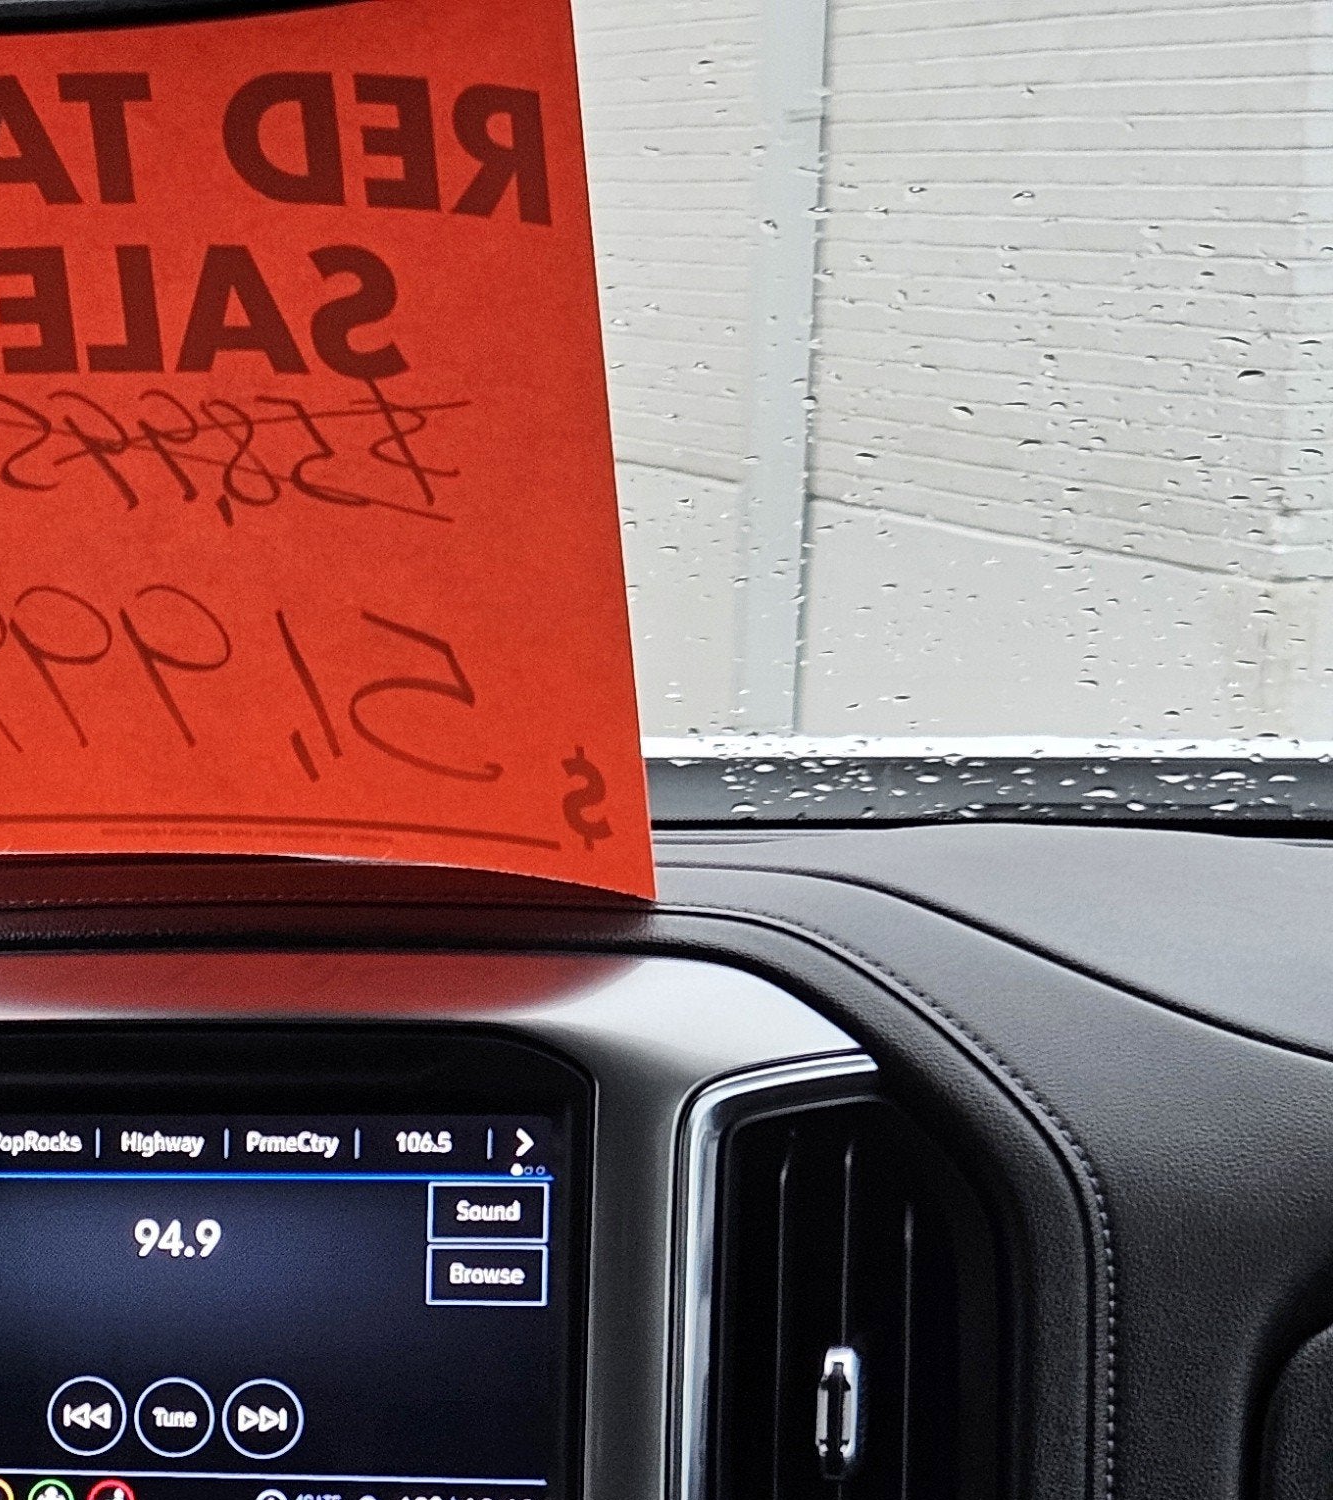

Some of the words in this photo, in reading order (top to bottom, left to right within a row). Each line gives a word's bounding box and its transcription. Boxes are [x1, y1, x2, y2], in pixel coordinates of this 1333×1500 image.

[121, 1130, 205, 1158] Highway
[246, 1130, 340, 1158] PrmeCtry
[396, 1131, 453, 1153] 106.5
[456, 1200, 521, 1222] Sound
[134, 1218, 222, 1258] 94.9
[449, 1262, 525, 1285] Browse
[152, 1406, 197, 1428] Tune
